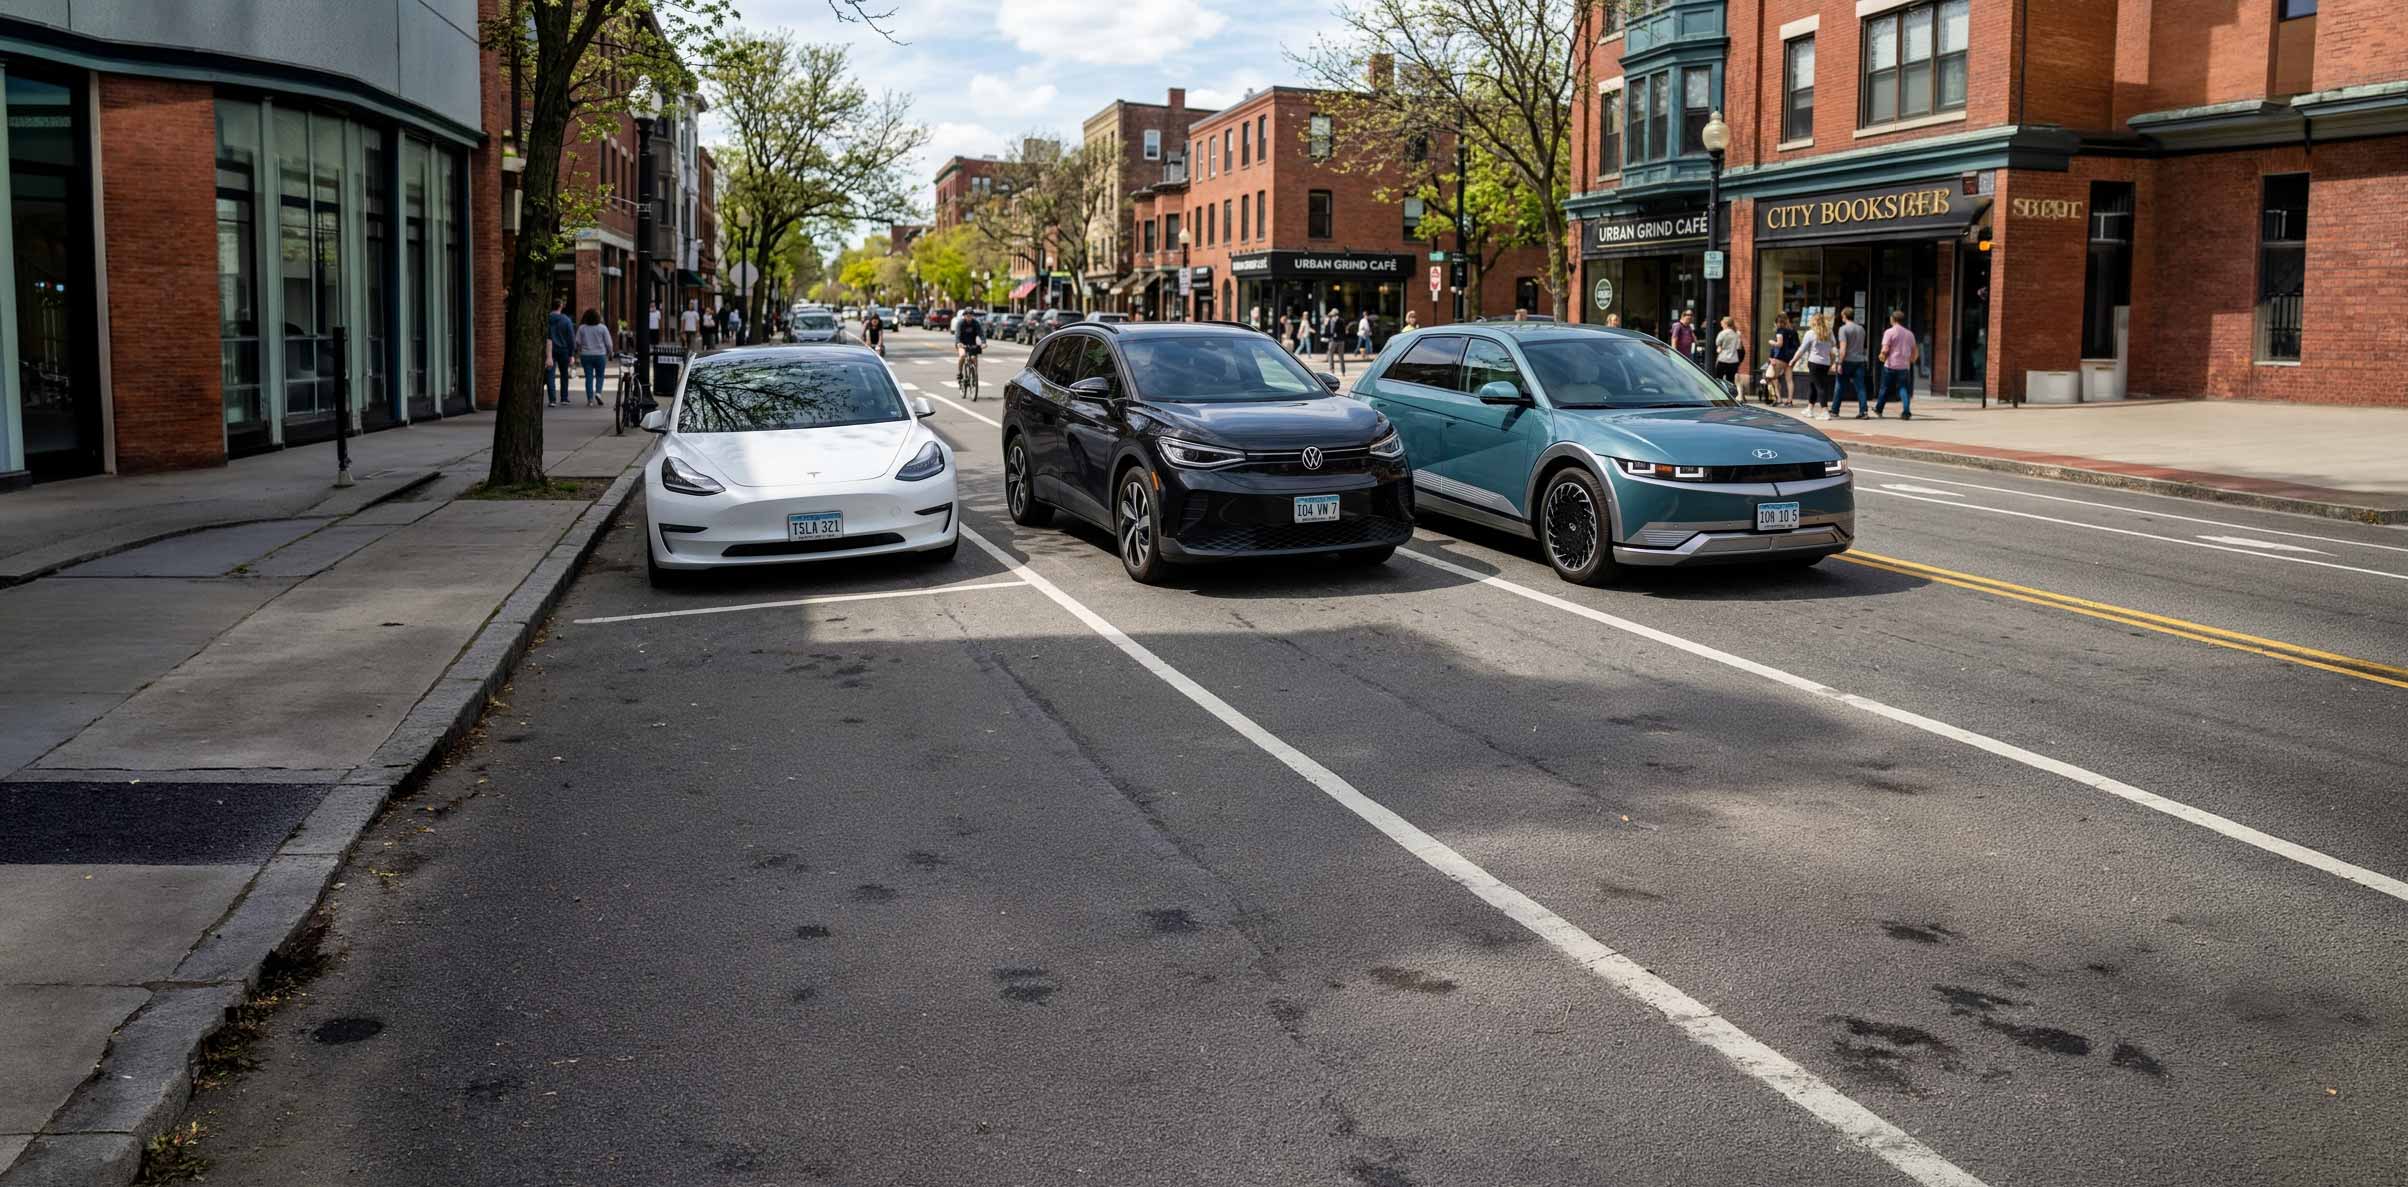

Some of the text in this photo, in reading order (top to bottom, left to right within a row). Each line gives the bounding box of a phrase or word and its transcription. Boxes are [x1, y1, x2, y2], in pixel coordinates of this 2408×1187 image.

[1767, 204, 1816, 229] CITY
[1599, 211, 1708, 242] URBAN GRIND CAFÉ
[1294, 258, 1397, 271] URBAN GRIND CAFÉ
[1331, 502, 1337, 515] 7
[1792, 509, 1797, 522] 5
[792, 519, 840, 536] TSLA 321
